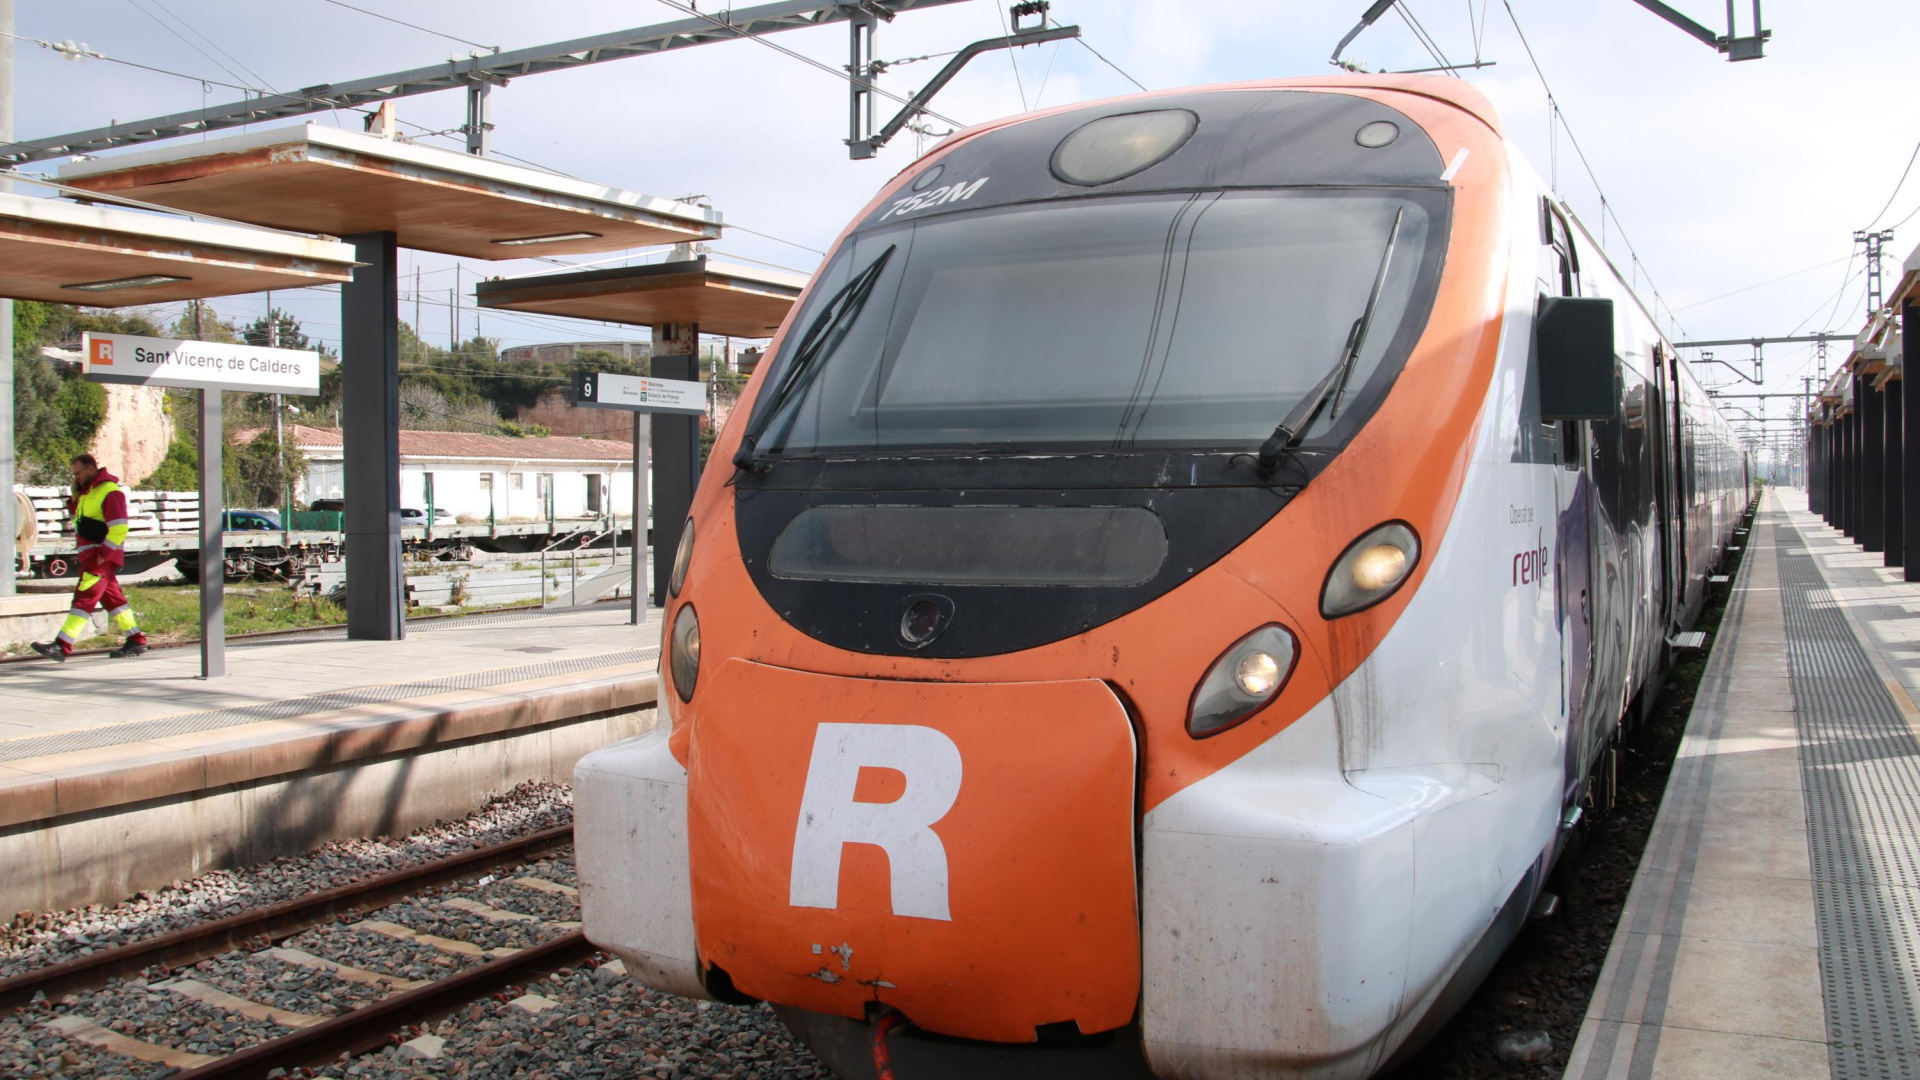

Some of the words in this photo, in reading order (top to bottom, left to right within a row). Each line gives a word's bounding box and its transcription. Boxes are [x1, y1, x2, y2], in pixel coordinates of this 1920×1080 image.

[878, 177, 990, 222] 752M
[99, 343, 113, 360] R
[134, 346, 171, 365] Sant
[174, 351, 224, 372] Vicenç
[227, 355, 245, 371] de
[249, 357, 301, 375] Calders
[584, 382, 592, 398] 9
[1512, 525, 1548, 600] renfe
[788, 721, 964, 922] R
